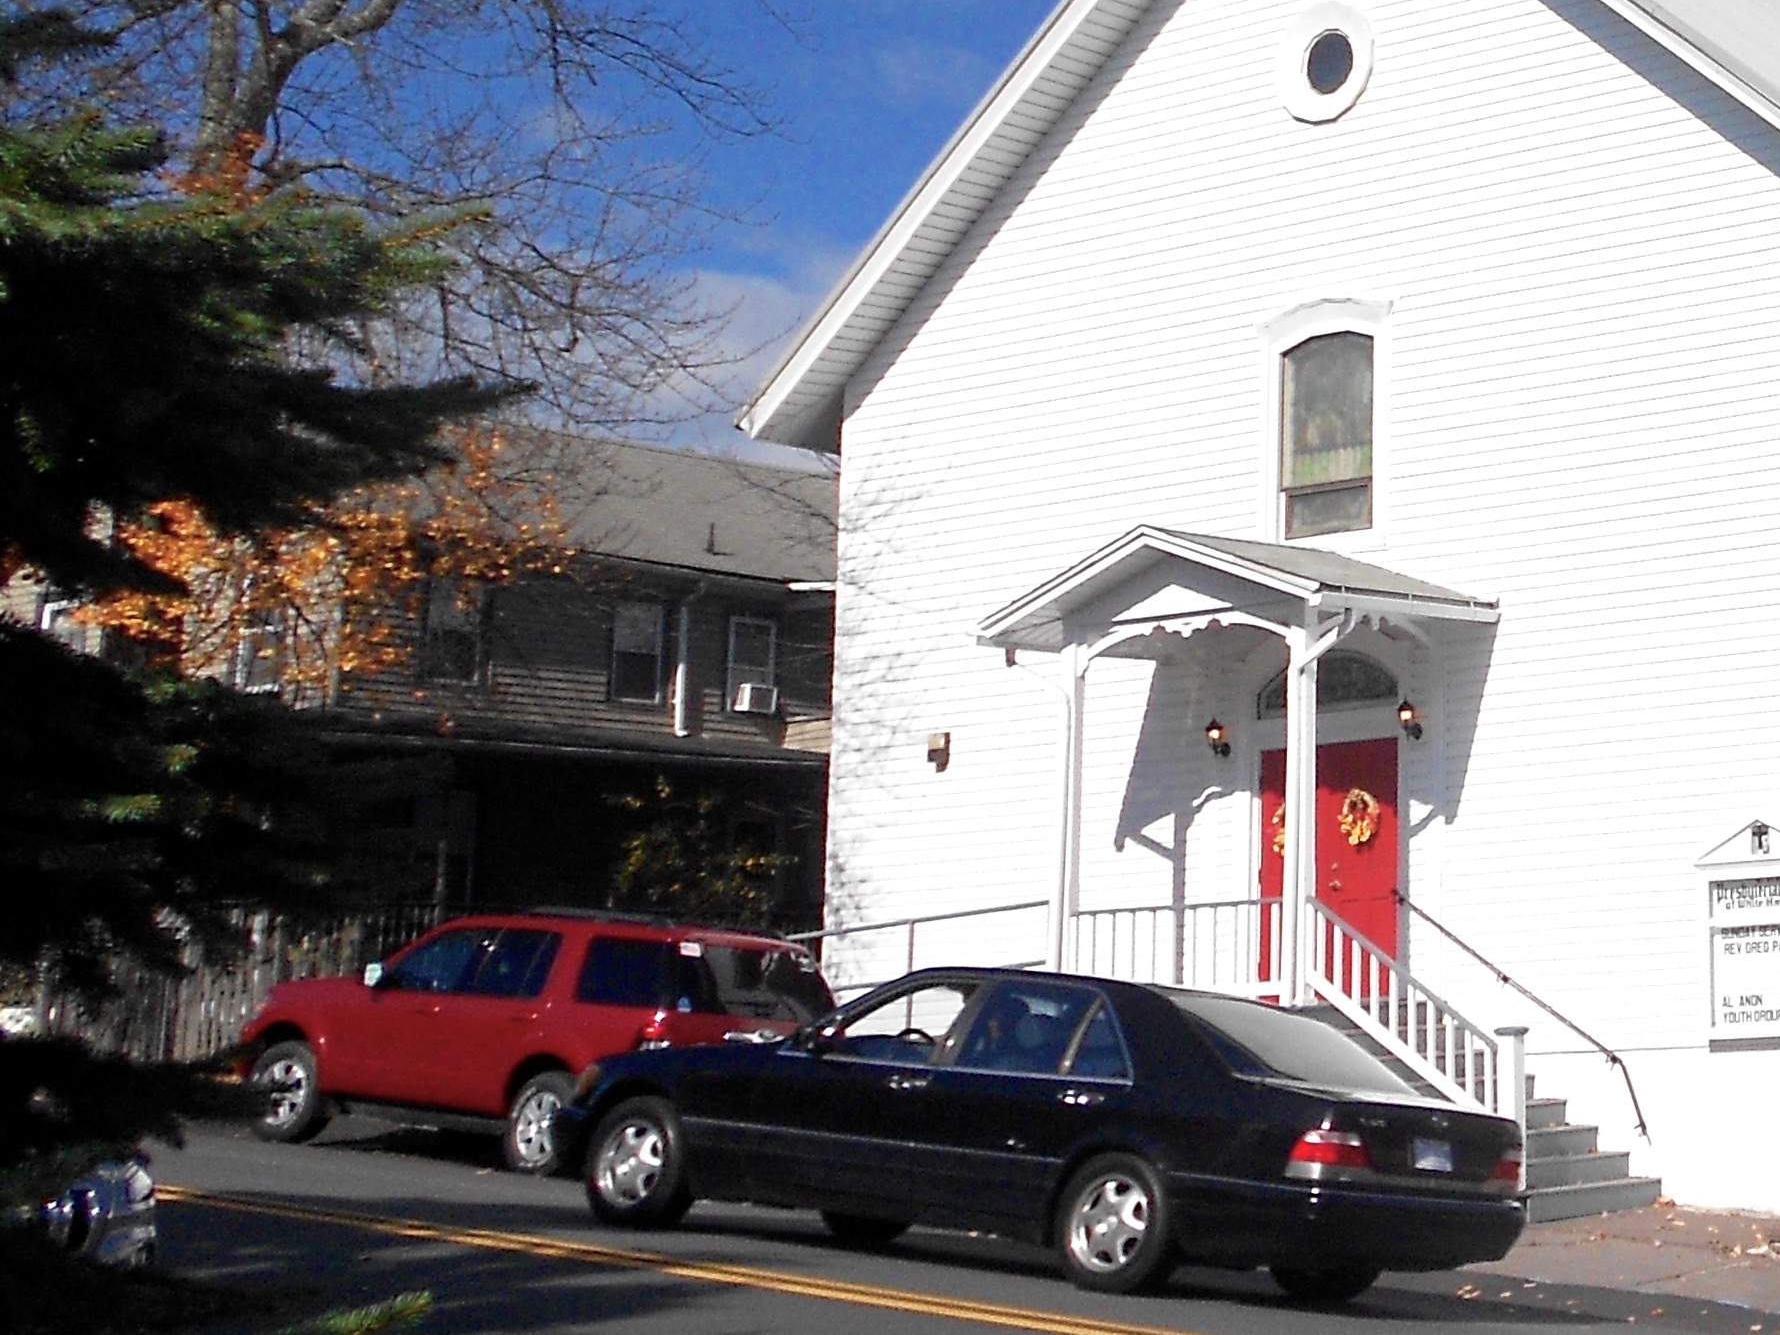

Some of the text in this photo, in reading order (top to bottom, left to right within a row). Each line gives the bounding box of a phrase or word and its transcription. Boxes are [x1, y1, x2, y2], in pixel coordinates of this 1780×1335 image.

[1724, 942, 1741, 954] REV
[1722, 994, 1763, 1007] AL ANON
[1723, 1011, 1752, 1023] YOUTH
